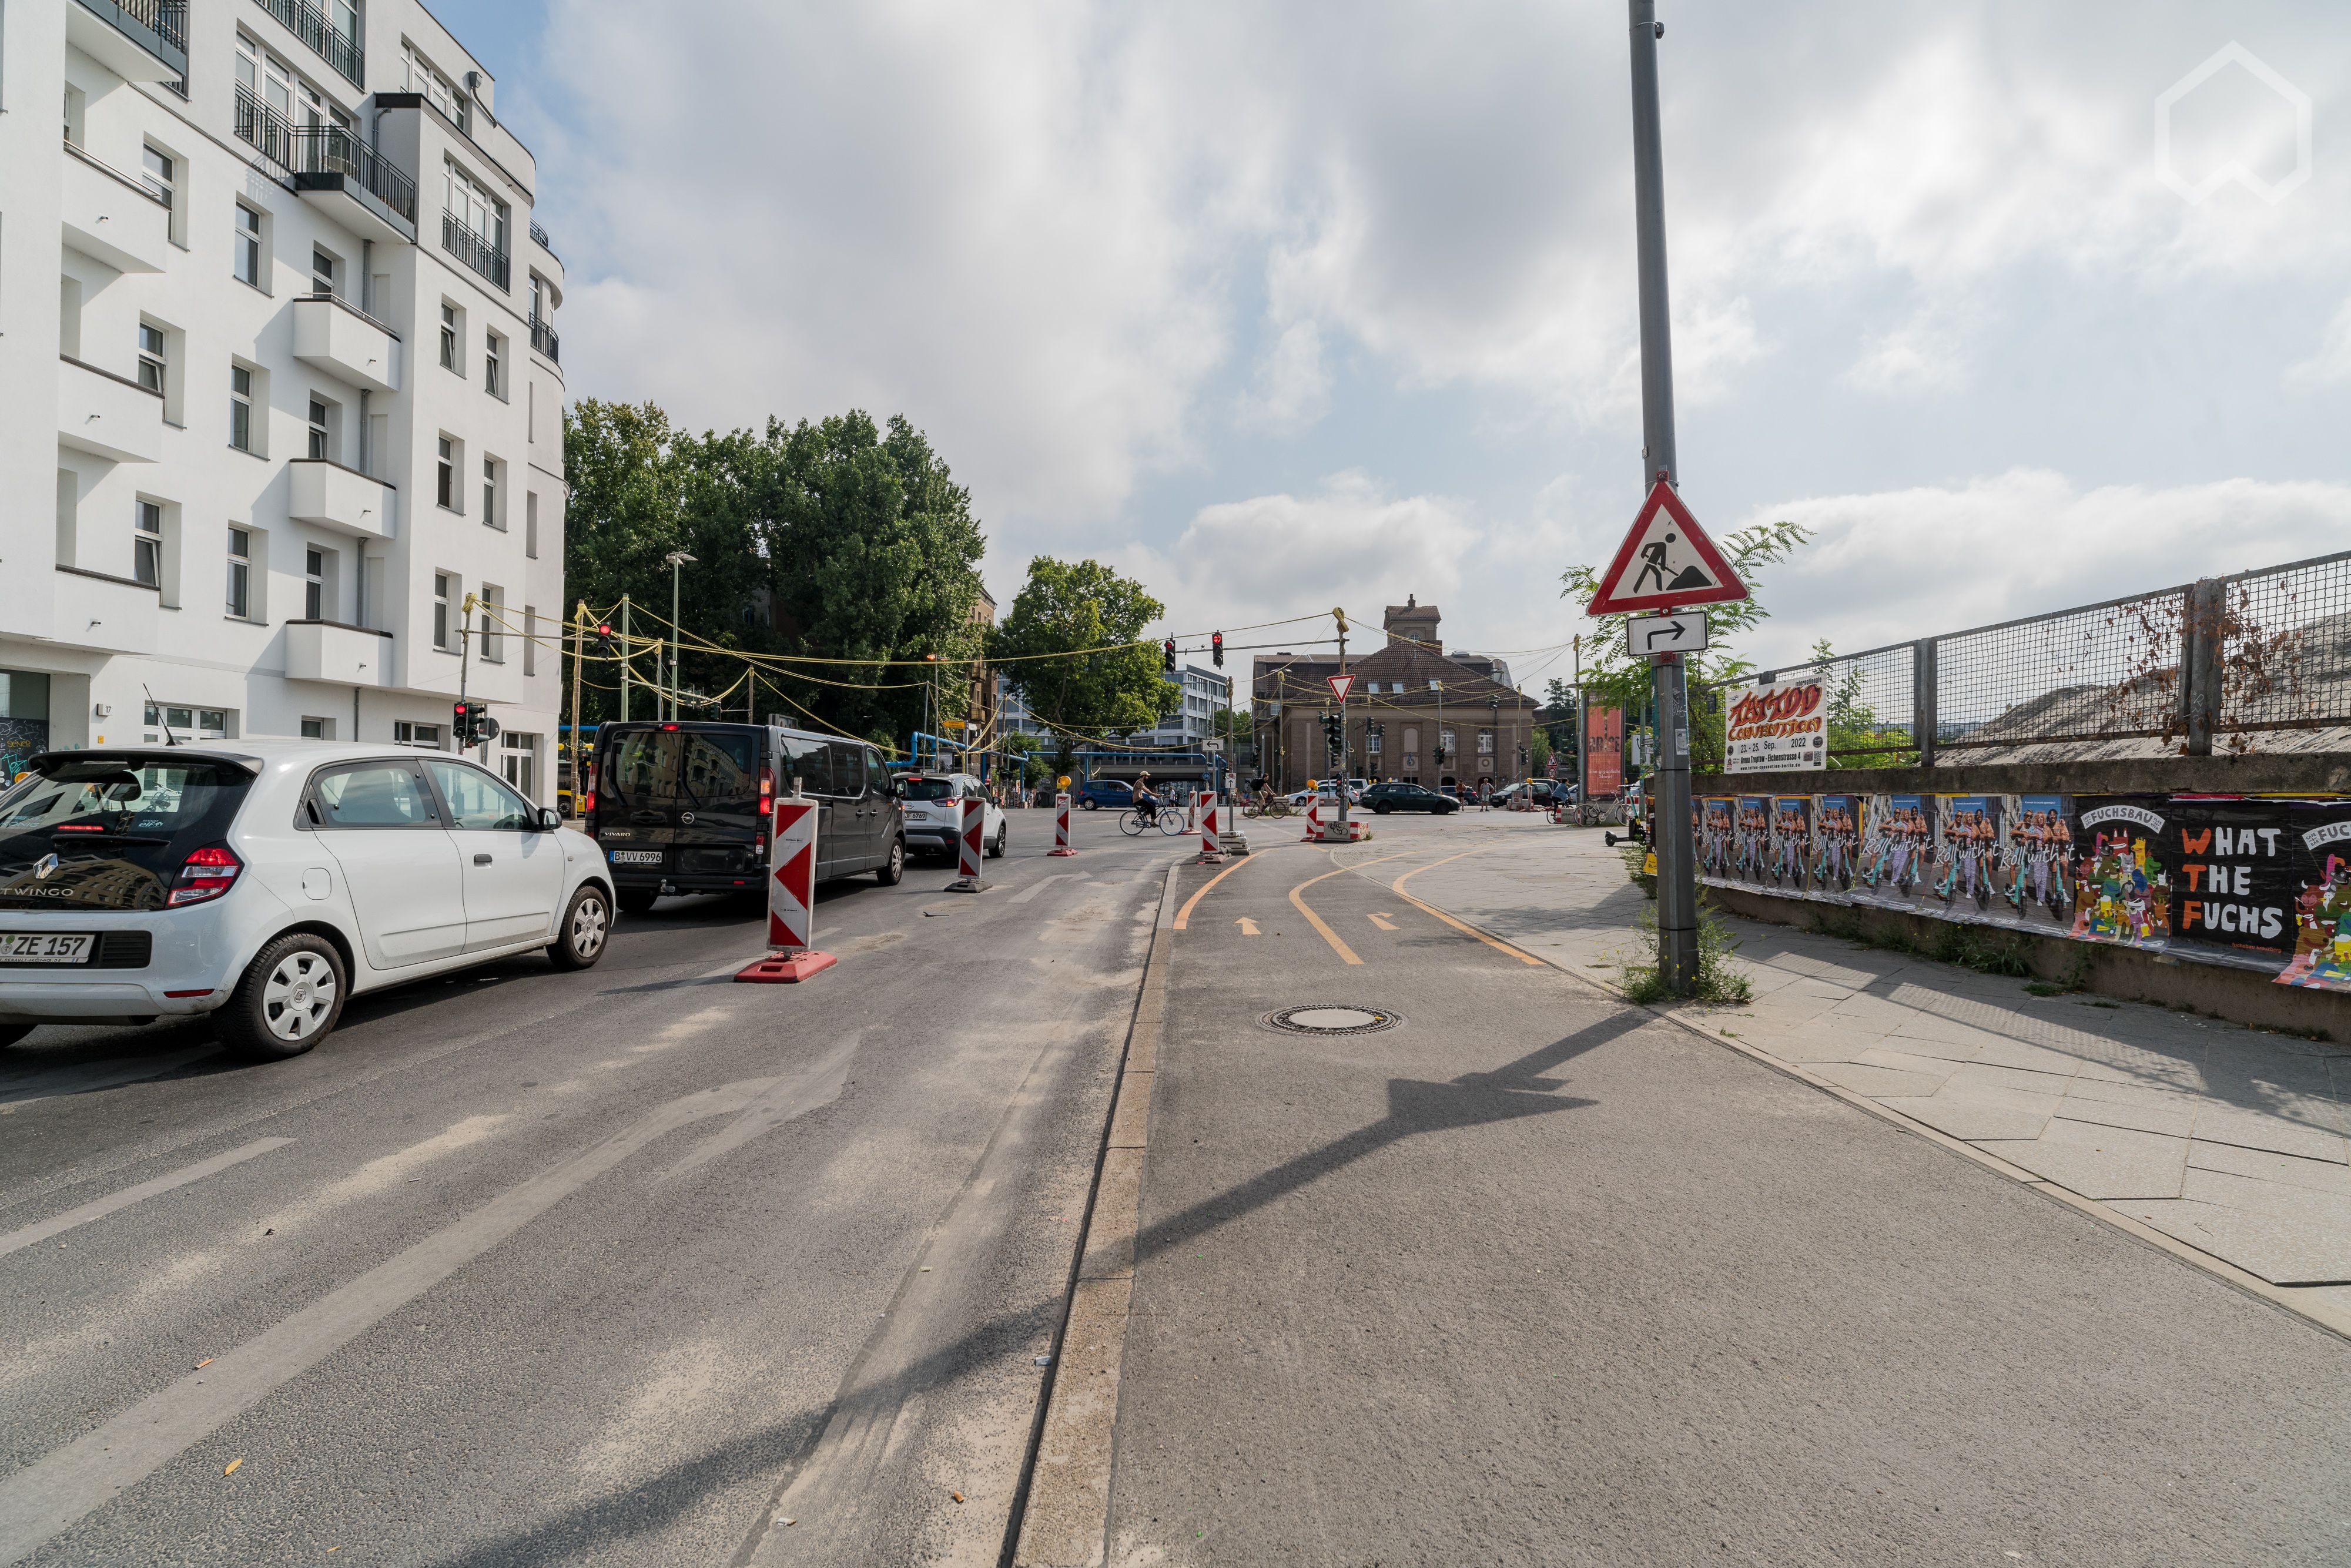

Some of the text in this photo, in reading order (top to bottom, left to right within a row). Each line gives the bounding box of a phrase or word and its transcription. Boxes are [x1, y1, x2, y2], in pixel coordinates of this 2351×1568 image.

[1728, 684, 1823, 728] TATTOO
[1764, 741, 1776, 751] Sep.
[1791, 738, 1806, 748] 2022
[1751, 755, 1765, 763] Treptow
[1768, 753, 1797, 762] Eichenstrasse
[1797, 752, 1801, 760] 4
[2090, 807, 2154, 823] FUCHSBAU
[1734, 831, 1746, 847] Roll
[1746, 829, 1761, 843] with
[1770, 834, 1783, 852] Roll
[1784, 833, 1800, 847] with
[1812, 834, 1826, 853] Roll
[1828, 833, 1847, 848] with
[2181, 826, 2281, 857] WHAT
[2317, 825, 2351, 842] FUC
[1862, 837, 1891, 855] Roll
[1890, 835, 1919, 852] with
[1934, 843, 1957, 866] Roll
[1959, 840, 1986, 859] with
[615, 852, 661, 862] B VV 6996
[2000, 845, 2025, 869] Roll
[2028, 843, 2060, 863] with
[2181, 864, 2252, 896] THE
[1, 888, 74, 896] TWINGO
[1994, 917, 2018, 925] TIER
[2182, 900, 2283, 939] FUCHS
[12, 936, 87, 956] ZE 157
